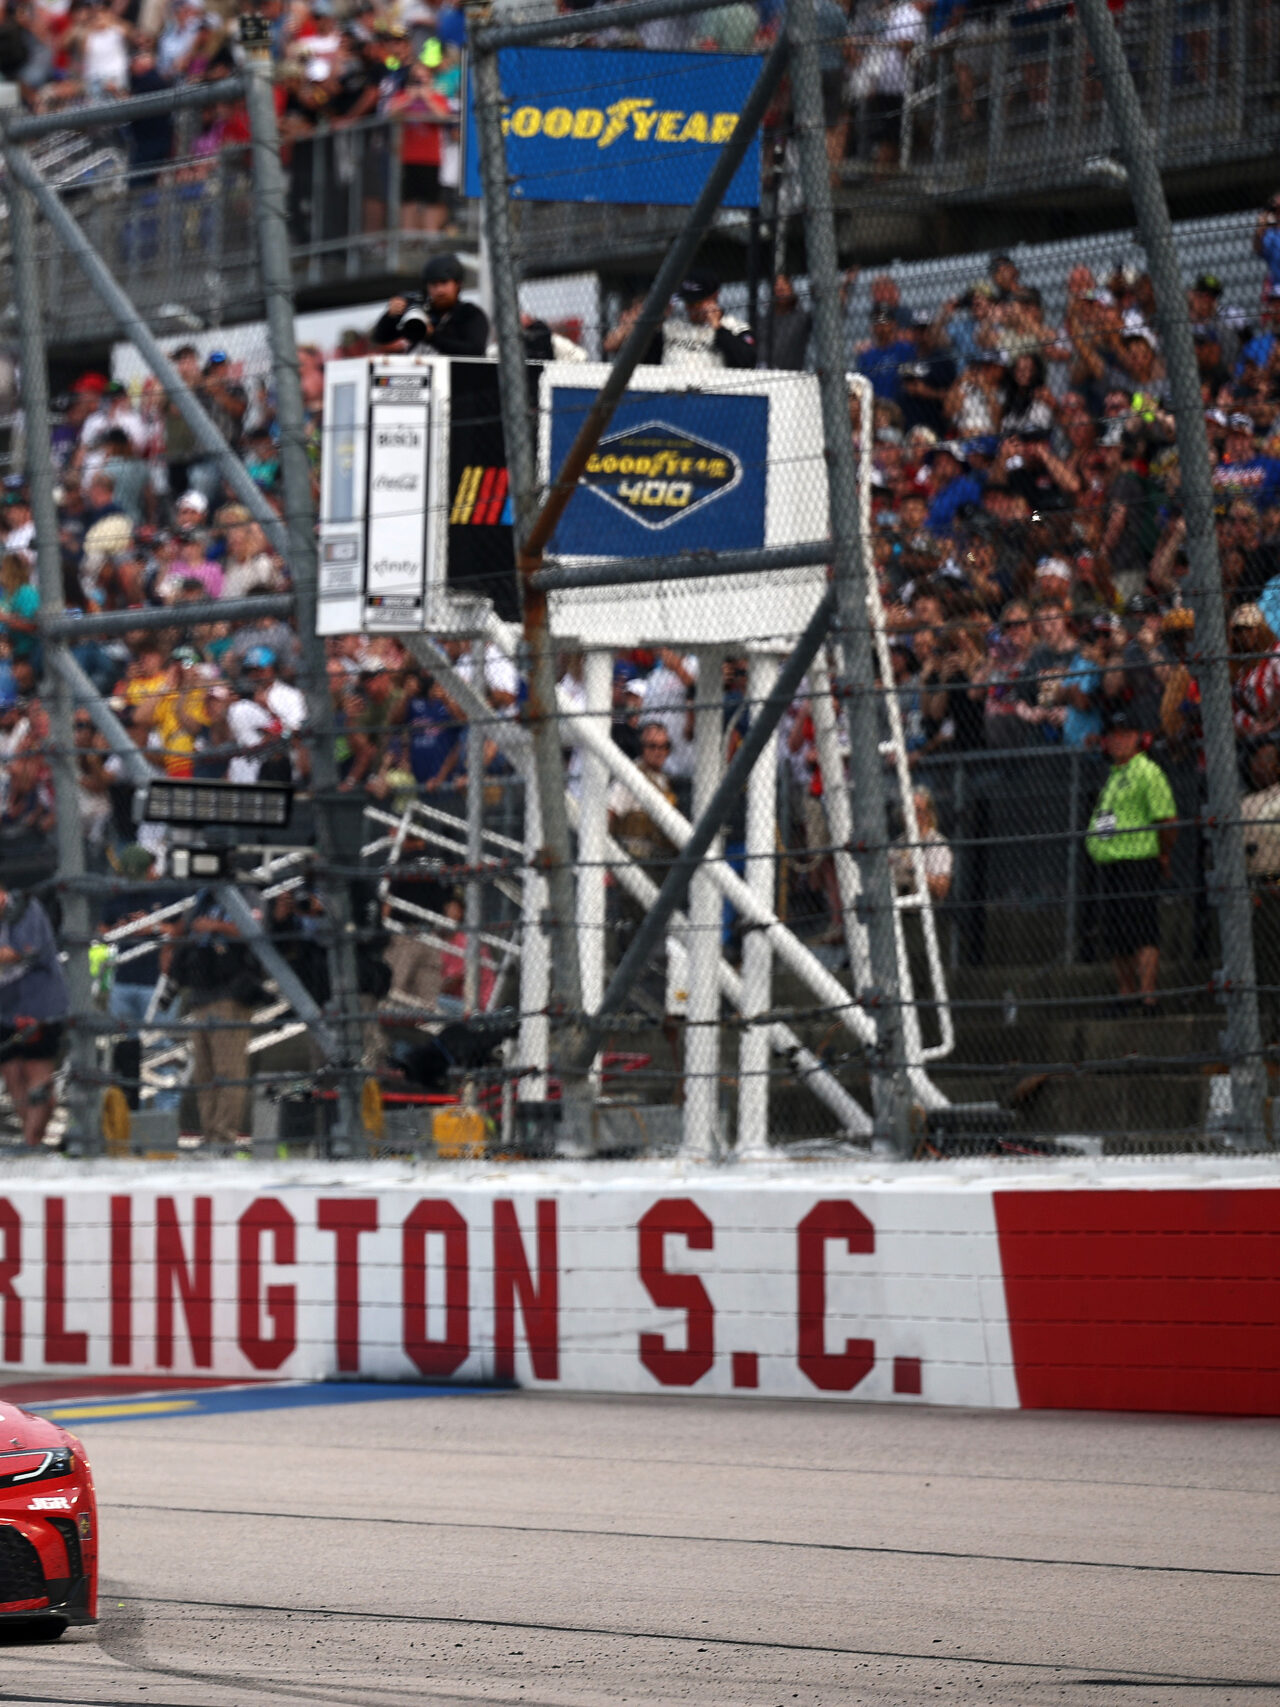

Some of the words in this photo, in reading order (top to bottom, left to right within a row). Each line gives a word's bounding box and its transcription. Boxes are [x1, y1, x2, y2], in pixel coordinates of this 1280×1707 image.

[585, 449, 729, 479] GOODYEAR
[618, 480, 694, 507] 400
[638, 1197, 922, 1394] S.C.
